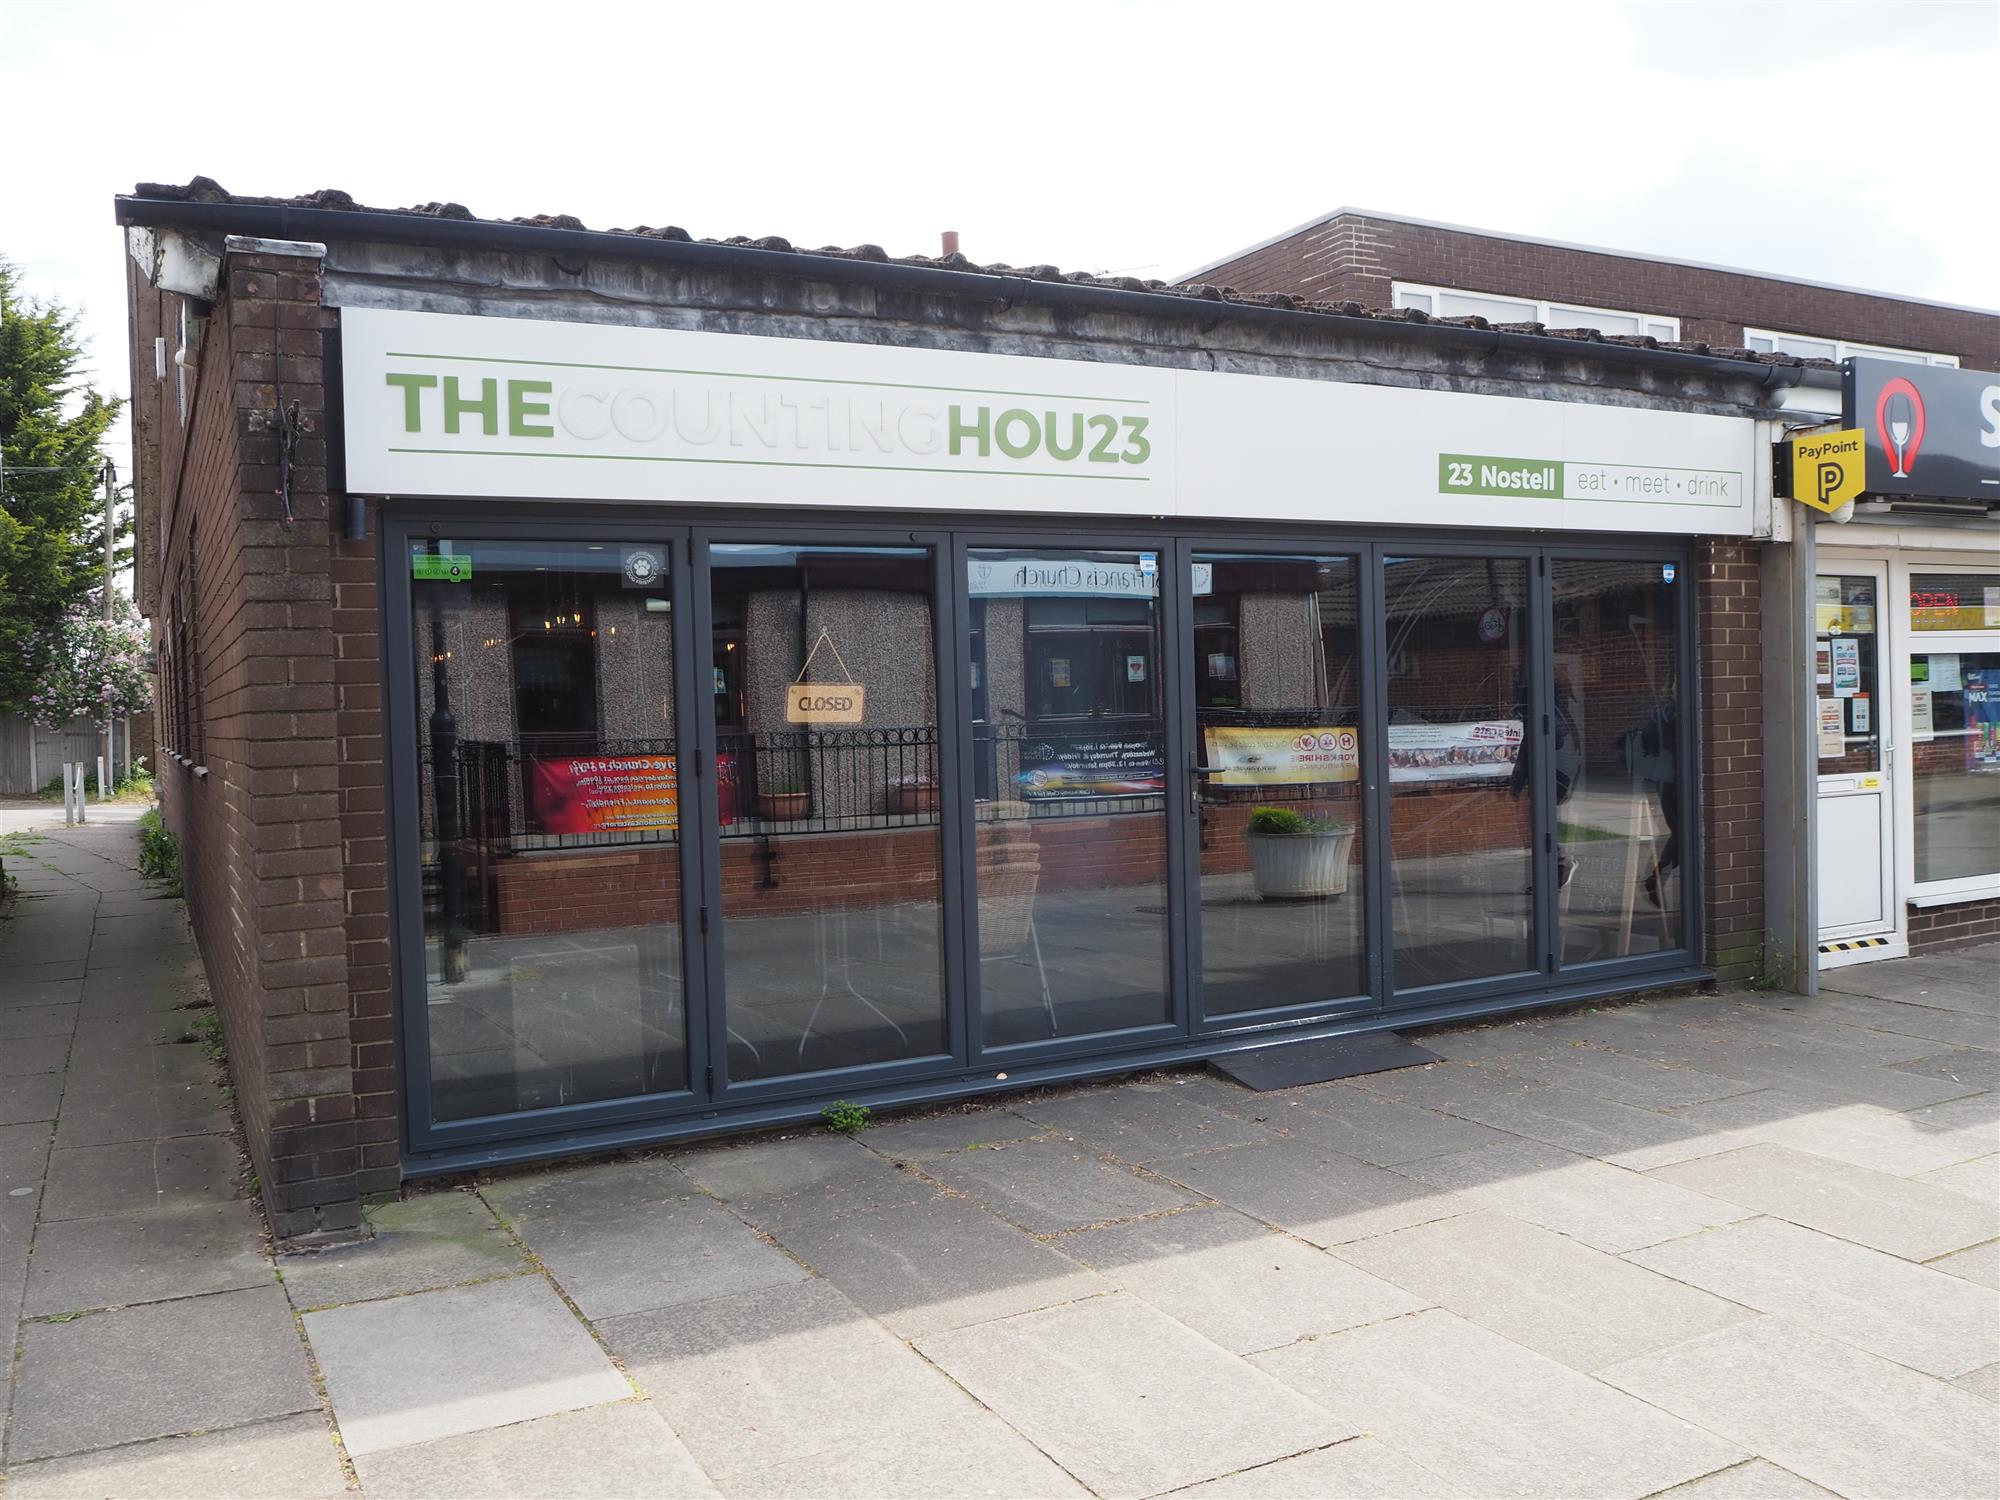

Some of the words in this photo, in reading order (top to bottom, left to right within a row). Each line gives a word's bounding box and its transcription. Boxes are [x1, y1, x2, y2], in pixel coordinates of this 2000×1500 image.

[1798, 440, 1859, 459] PayPoint
[1447, 462, 1474, 487] 23
[1480, 464, 1556, 491] Nostell
[1577, 469, 1608, 491] eat
[1625, 472, 1671, 494] meet
[1687, 475, 1729, 497] drink
[1910, 593, 1959, 616] OPEN
[798, 696, 853, 711] CLOSED
[1968, 691, 1988, 704] MAX
